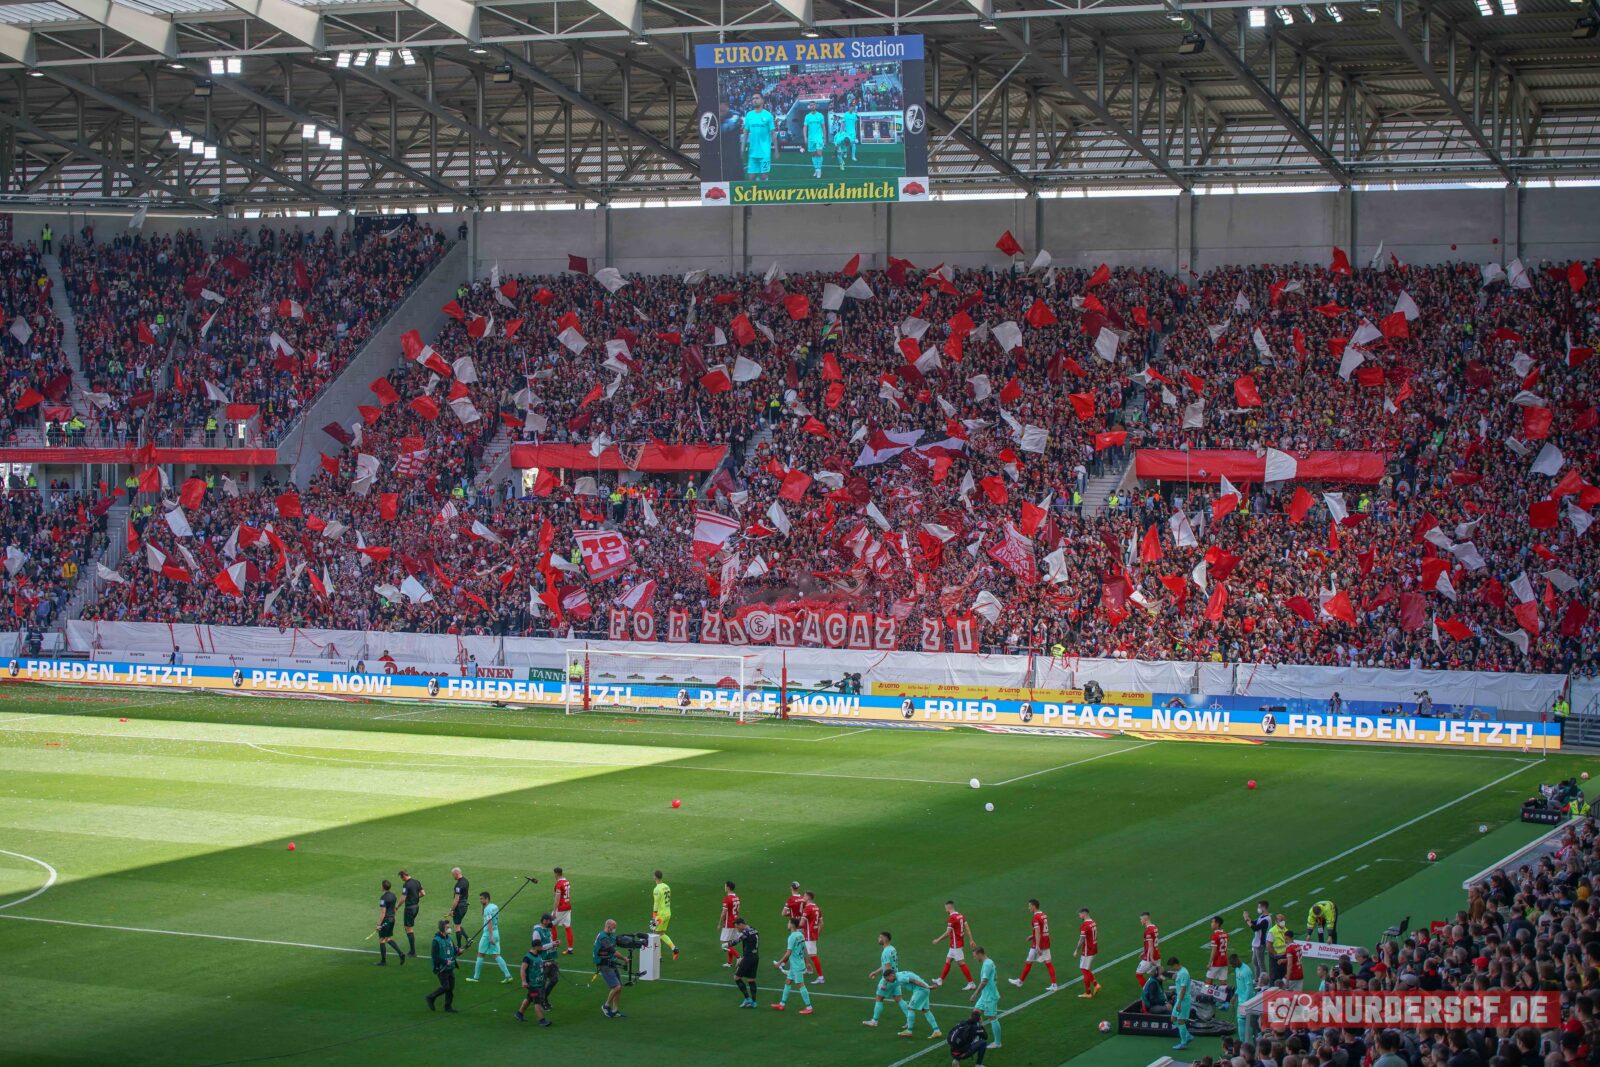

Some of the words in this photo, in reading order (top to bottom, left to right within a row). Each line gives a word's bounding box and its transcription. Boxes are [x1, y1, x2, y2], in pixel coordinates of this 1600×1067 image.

[714, 45, 788, 64] EUROPA
[795, 42, 846, 60] PARK
[851, 40, 905, 58] Stadion
[733, 181, 895, 202] Schwarzwaldmilch
[27, 660, 121, 682] FRIEDEN.
[125, 664, 193, 685] JETZT!
[251, 670, 326, 692] PEACE.
[332, 674, 392, 694] NOW!
[460, 666, 514, 679] TNNEN
[531, 669, 567, 682] TANNE
[448, 679, 552, 702] FRIEDEN.
[558, 684, 632, 704] JETZT!
[792, 695, 860, 716] NOW!
[924, 699, 997, 721] FRIED
[1043, 704, 1141, 728] PEACE.
[1152, 709, 1230, 732] NOW!
[1288, 714, 1425, 740] FRIEDEN.
[1435, 721, 1533, 745] JETZT!
[1318, 945, 1347, 955] hilzinger
